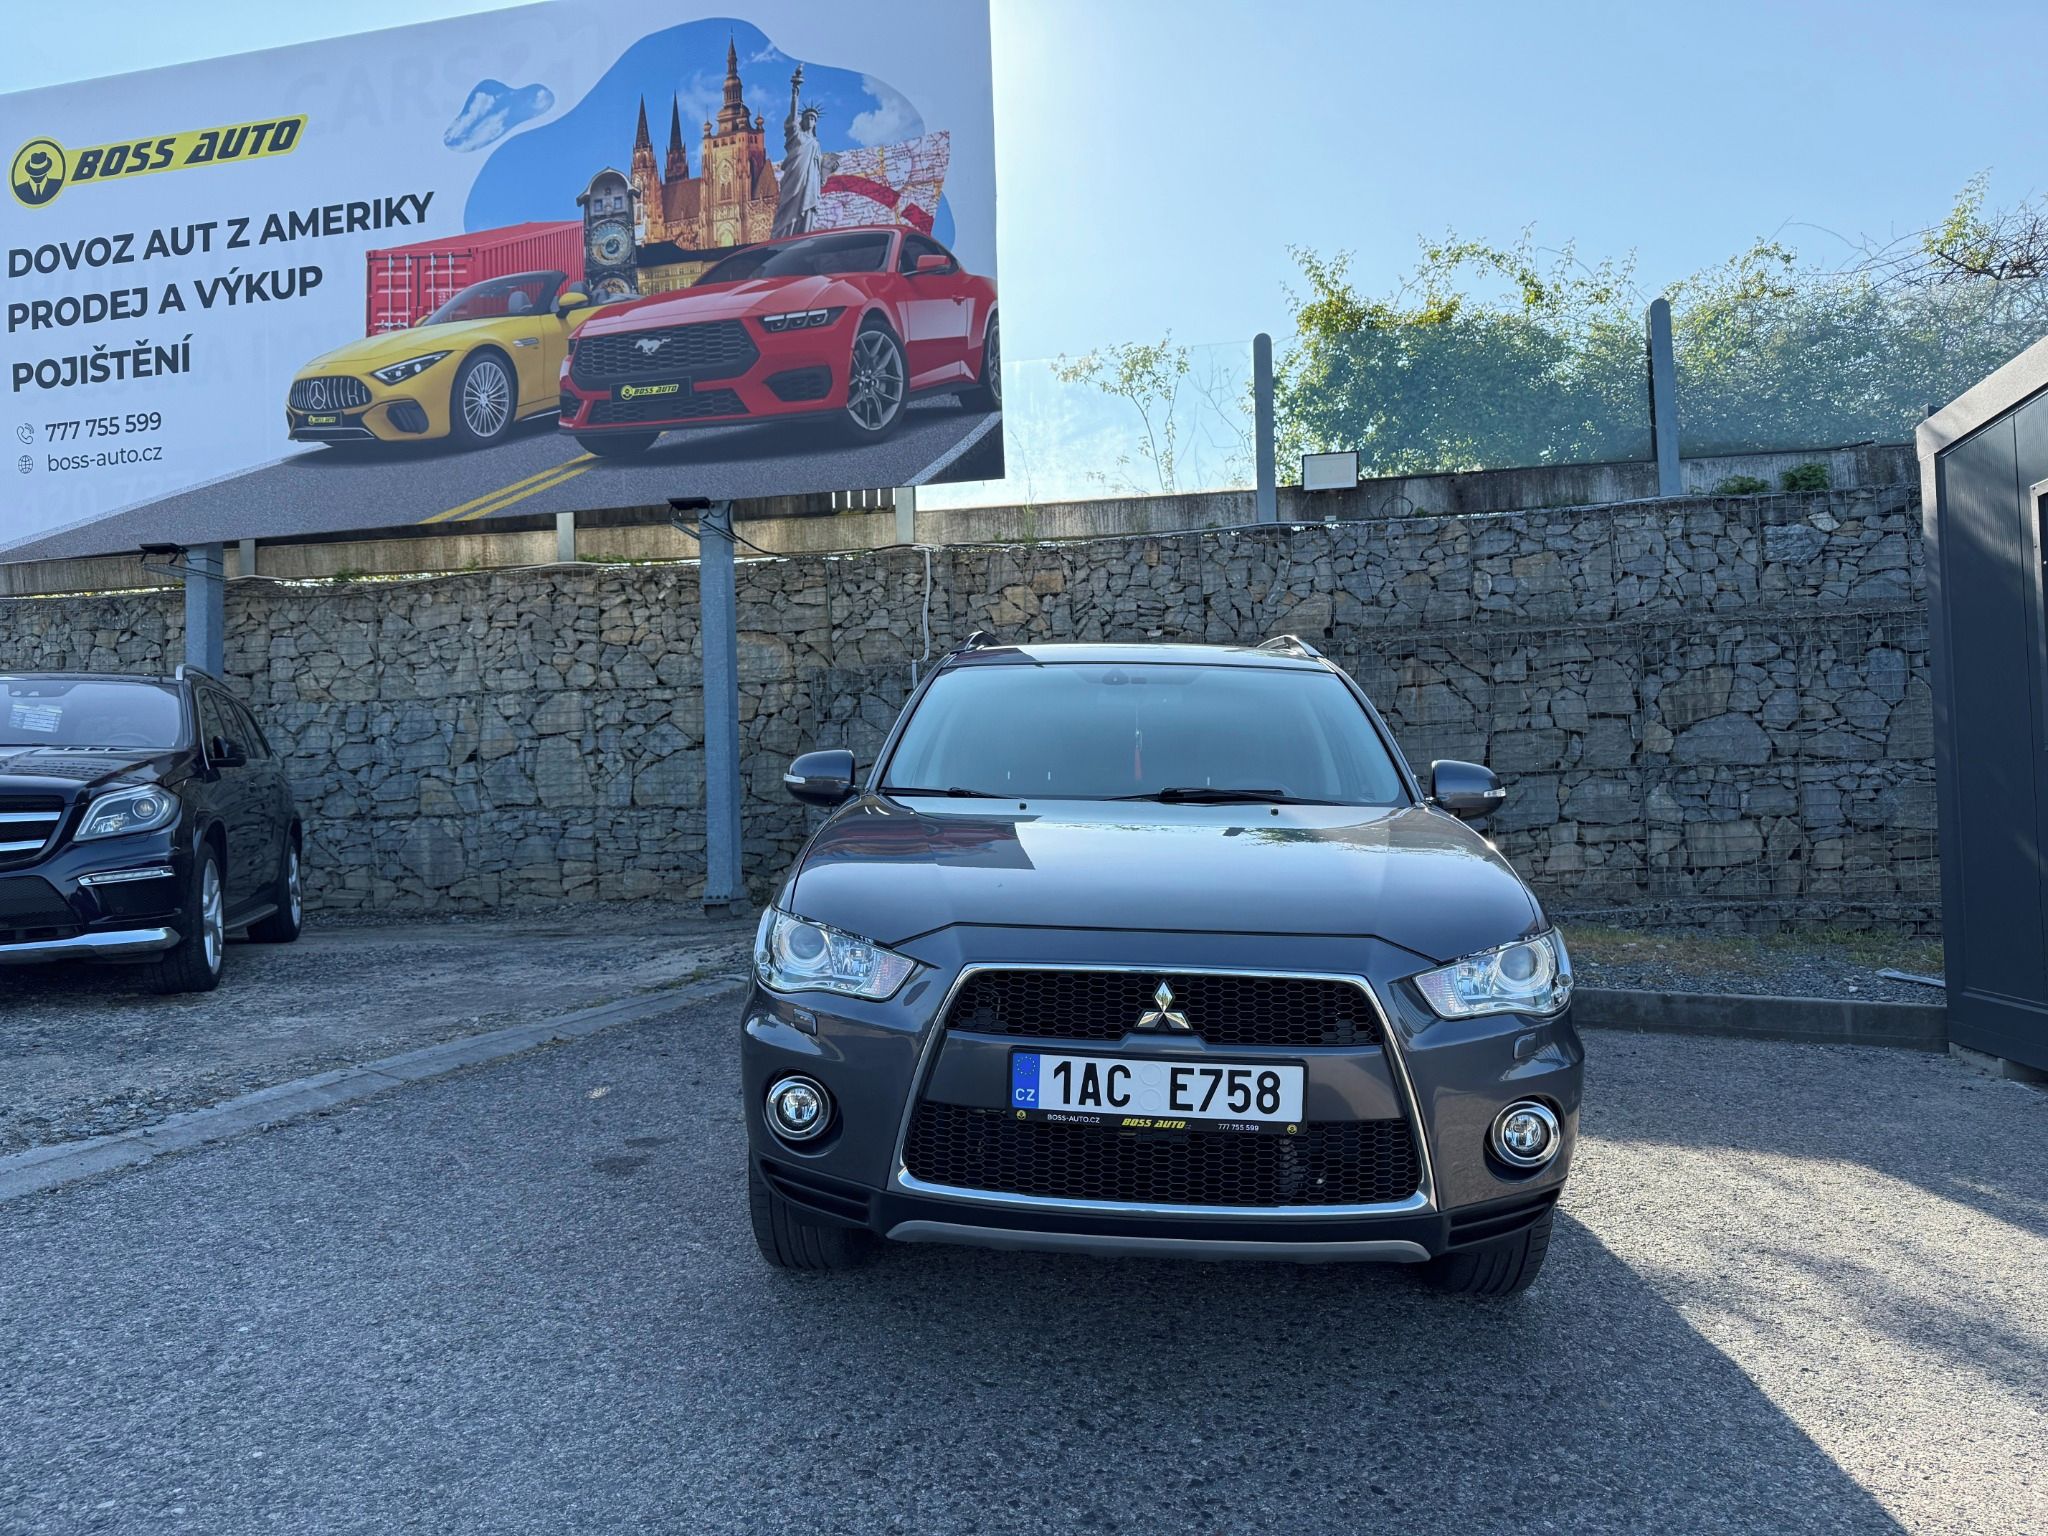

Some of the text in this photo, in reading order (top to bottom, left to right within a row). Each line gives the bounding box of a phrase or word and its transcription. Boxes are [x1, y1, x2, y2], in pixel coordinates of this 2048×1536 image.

[71, 119, 301, 181] BOSS AUTO
[9, 192, 434, 278] DOVOZ AUT Z AMERIKY
[8, 266, 322, 333] PRODEJ A VÝKUP
[12, 333, 193, 392] POJIŠTĚNÍ
[45, 412, 161, 442] 777 755 599
[48, 447, 162, 472] boss-auto.cz
[1015, 1088, 1035, 1101] CZ
[1053, 1061, 1281, 1114] 1AC E758
[1047, 1114, 1100, 1124] BOSS-AUTO.CZ
[1122, 1118, 1151, 1127] BOSS
[1154, 1120, 1186, 1129] AUTO
